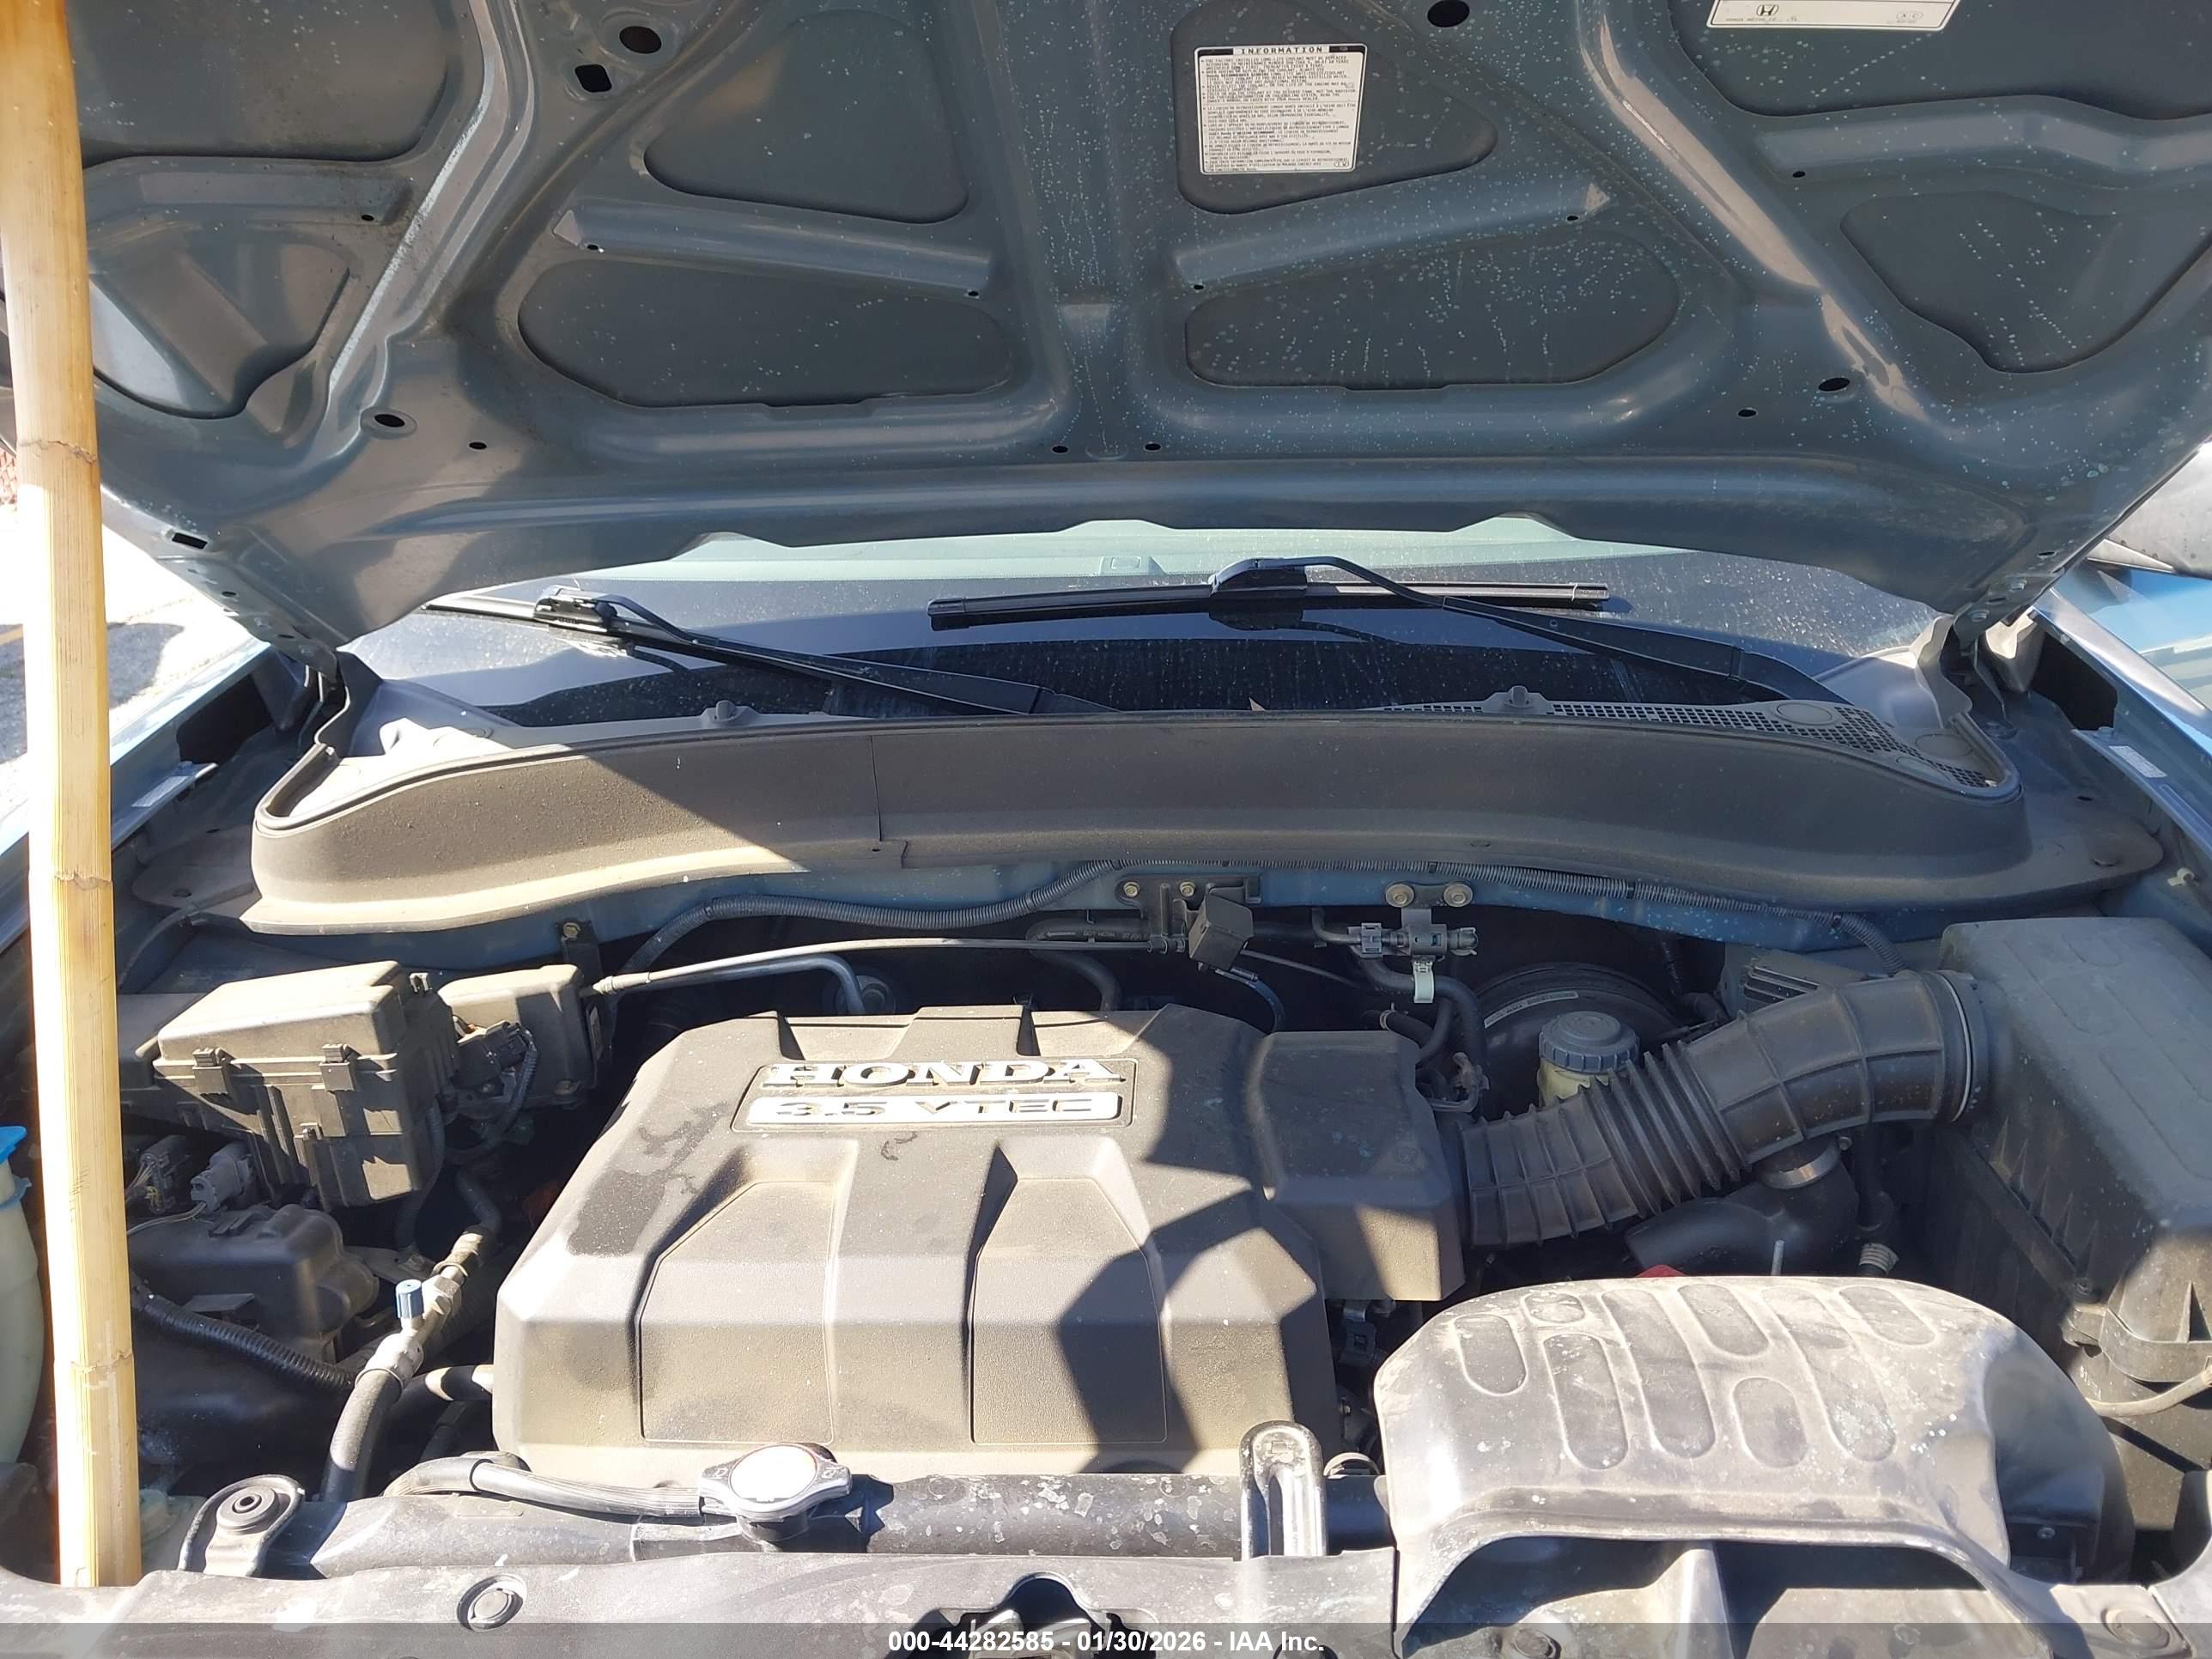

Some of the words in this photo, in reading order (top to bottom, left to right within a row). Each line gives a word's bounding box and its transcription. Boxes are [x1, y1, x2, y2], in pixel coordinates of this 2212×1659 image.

[1240, 46, 1323, 55] INFORMATION
[763, 1058, 1127, 1088] HONDA
[776, 1100, 888, 1116] 3.5
[915, 1098, 1093, 1115] VTEC
